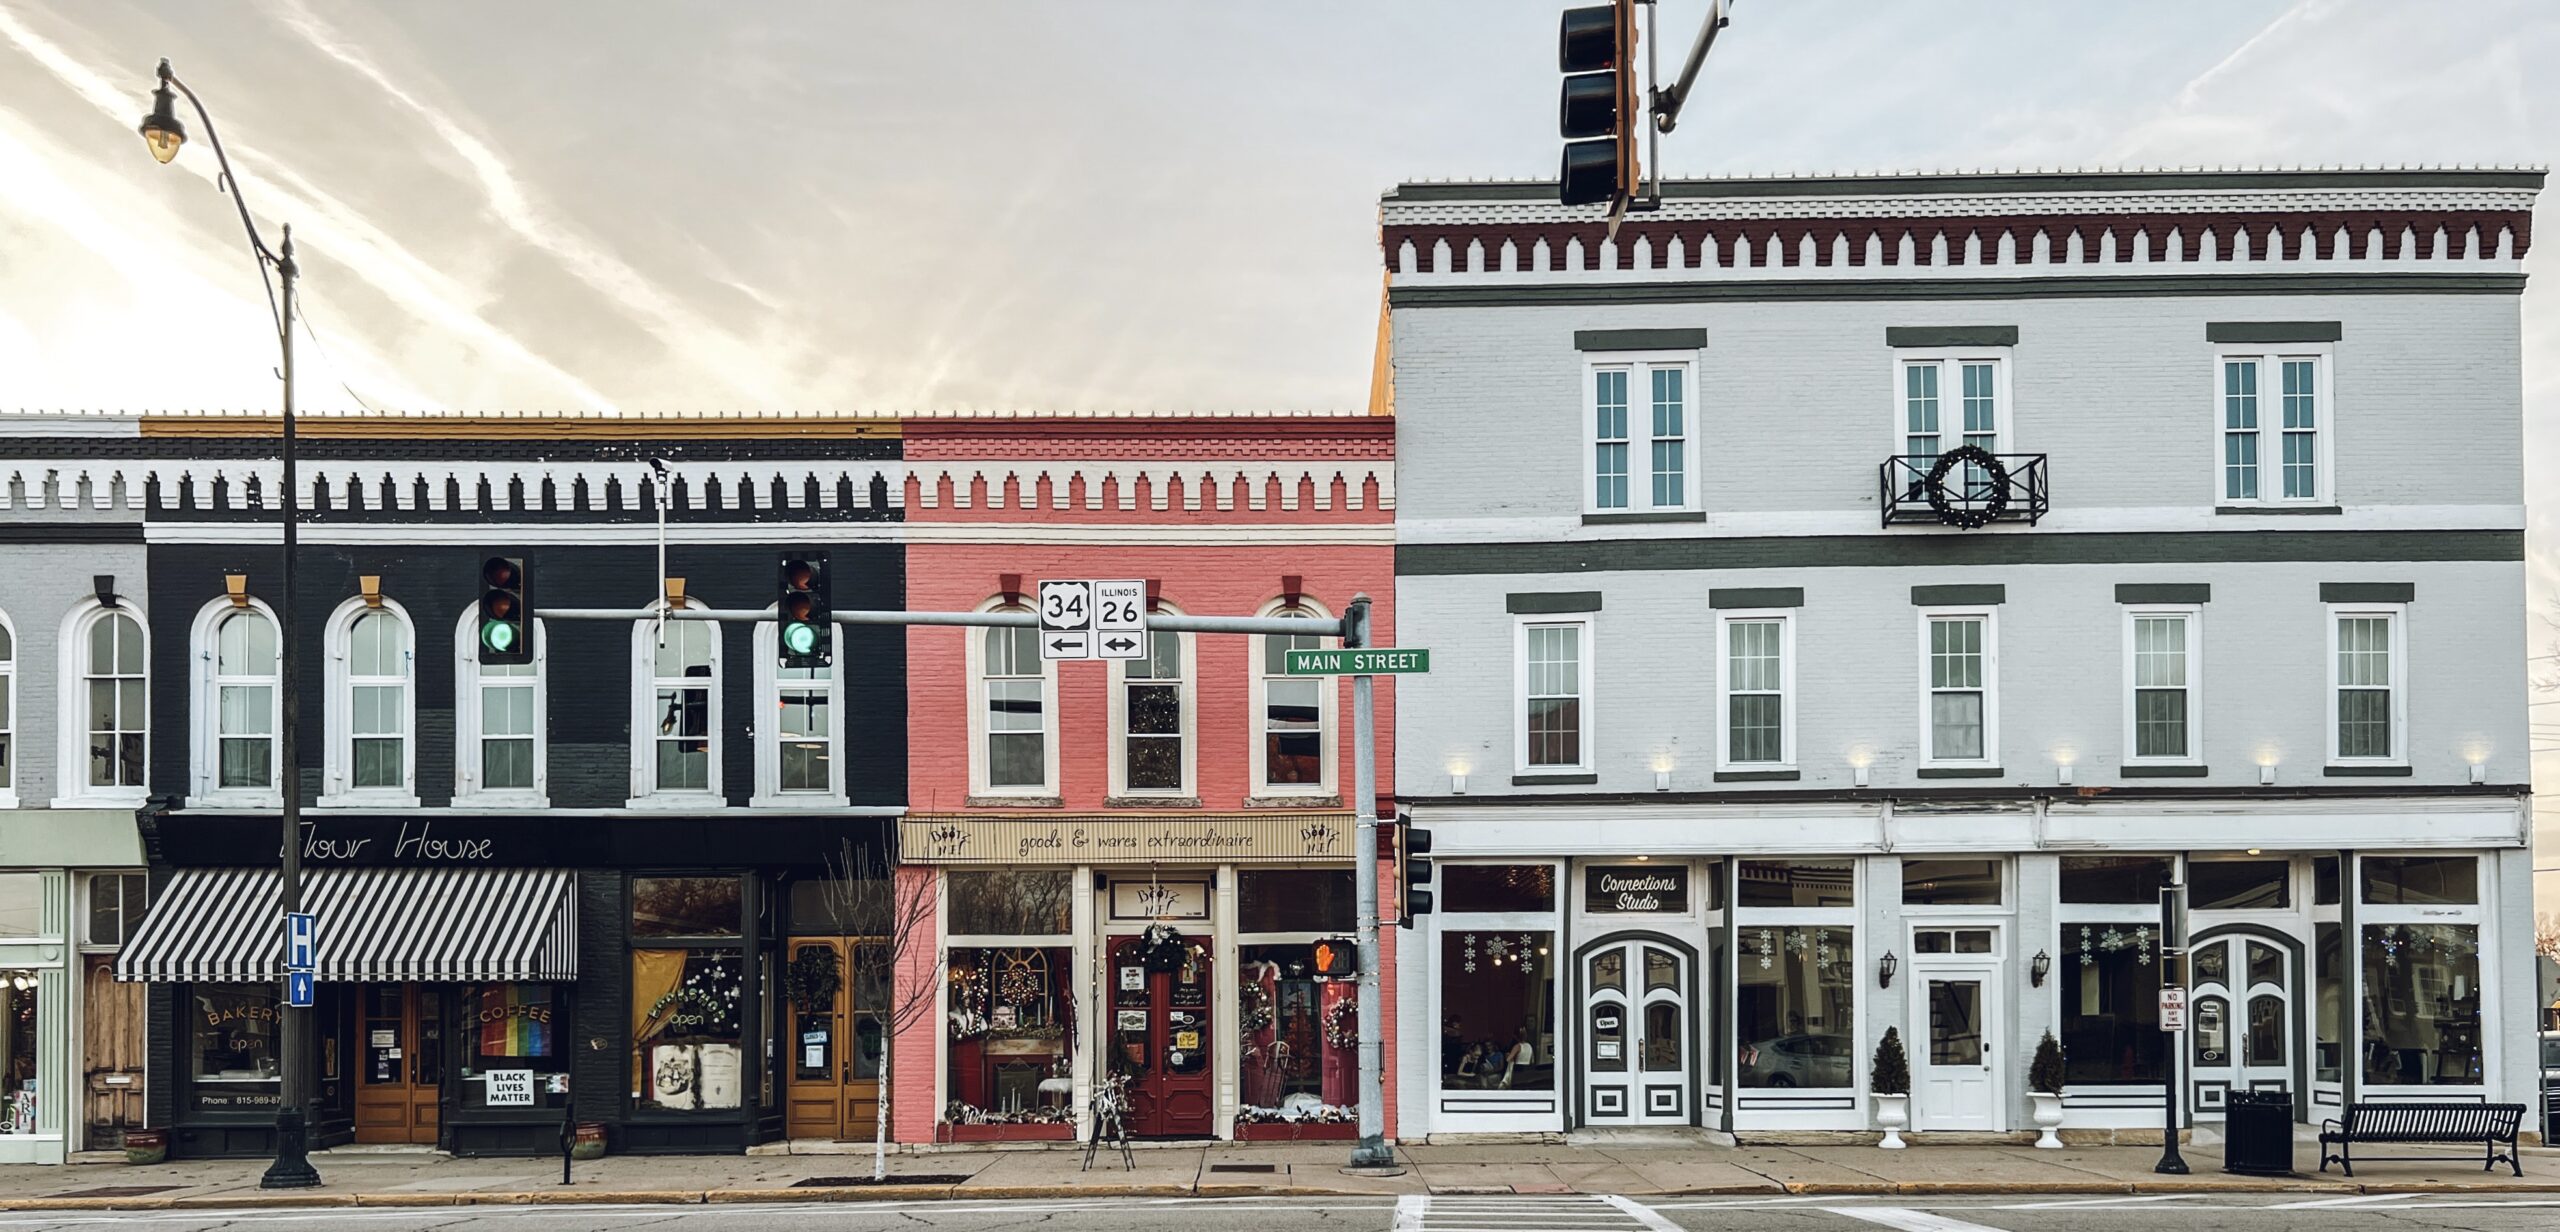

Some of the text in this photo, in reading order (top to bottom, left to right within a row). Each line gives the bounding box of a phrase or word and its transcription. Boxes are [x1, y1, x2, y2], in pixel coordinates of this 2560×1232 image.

[1101, 588, 1138, 597] ILLINOIS
[1047, 594, 1083, 618] 34
[1102, 600, 1138, 623] 26
[1298, 654, 1418, 670] MAIN STREET
[394, 821, 493, 858] House
[1018, 828, 1253, 857] goods & wares extraordinaire
[1600, 873, 1677, 893] Connections
[1615, 892, 1659, 910] Studio
[291, 917, 312, 966] H
[207, 1006, 282, 1026] BAKERY
[480, 1005, 551, 1023] COFFEE
[670, 1014, 704, 1027] open
[229, 1039, 263, 1053] open
[493, 1073, 526, 1081] BLACK
[496, 1083, 524, 1092] LIVES
[236, 1096, 282, 1105] 815-989-87
[490, 1093, 531, 1102] MATTER
